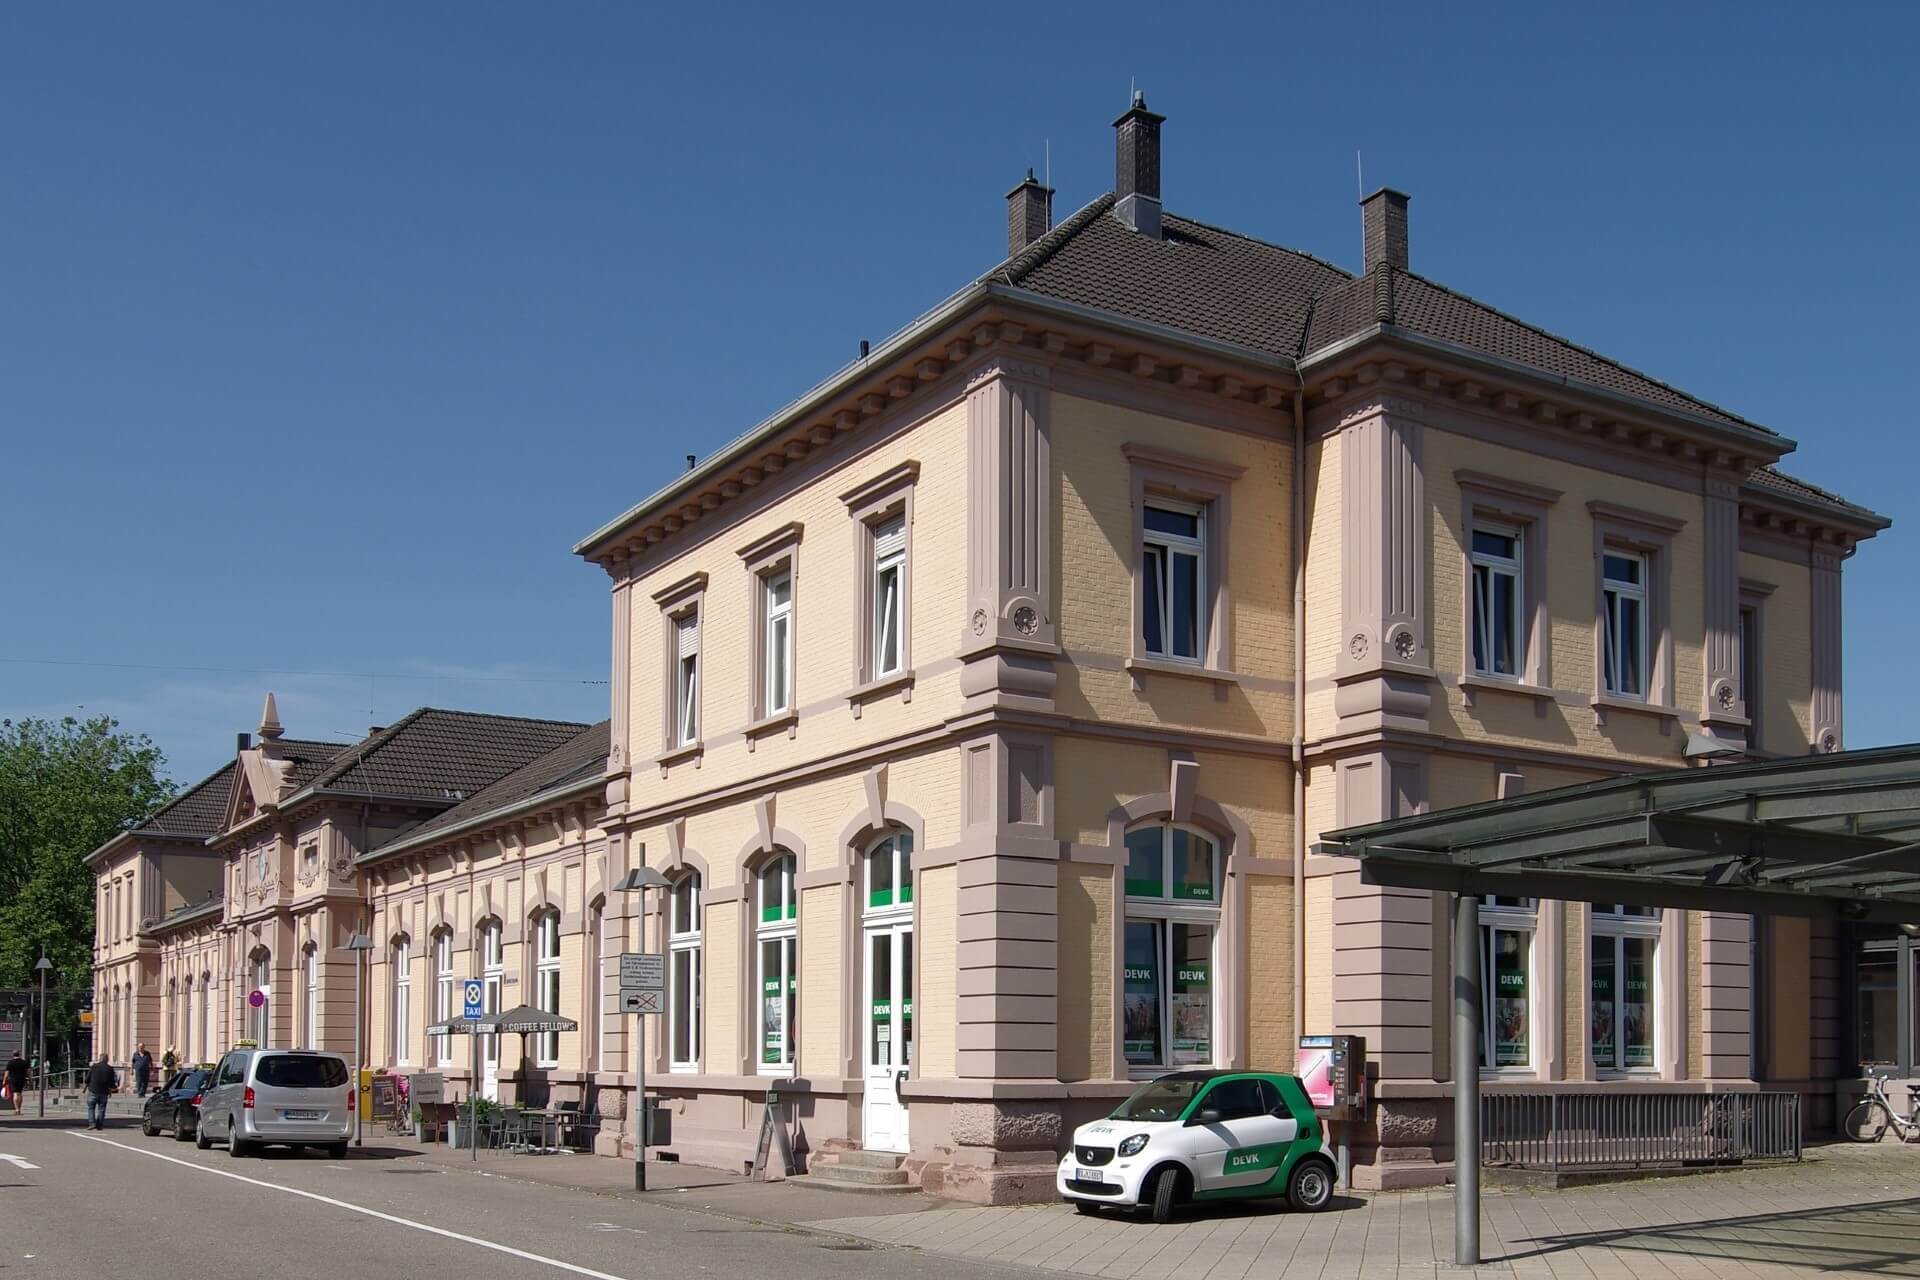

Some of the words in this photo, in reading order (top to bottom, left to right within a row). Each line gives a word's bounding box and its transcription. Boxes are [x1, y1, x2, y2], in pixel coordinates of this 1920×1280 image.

[1125, 969, 1150, 979] DEVK
[1179, 971, 1205, 980] DEVK
[1501, 975, 1524, 985] DEVK
[766, 982, 779, 990] DEVK
[1627, 981, 1647, 990] DEVK
[466, 1007, 480, 1015] TAXI
[873, 1005, 891, 1014] DEVK
[904, 1004, 912, 1013] DE
[508, 1022, 537, 1032] COFFEE
[540, 1020, 574, 1032] FELLOWS
[1232, 1153, 1259, 1165] DEVK
